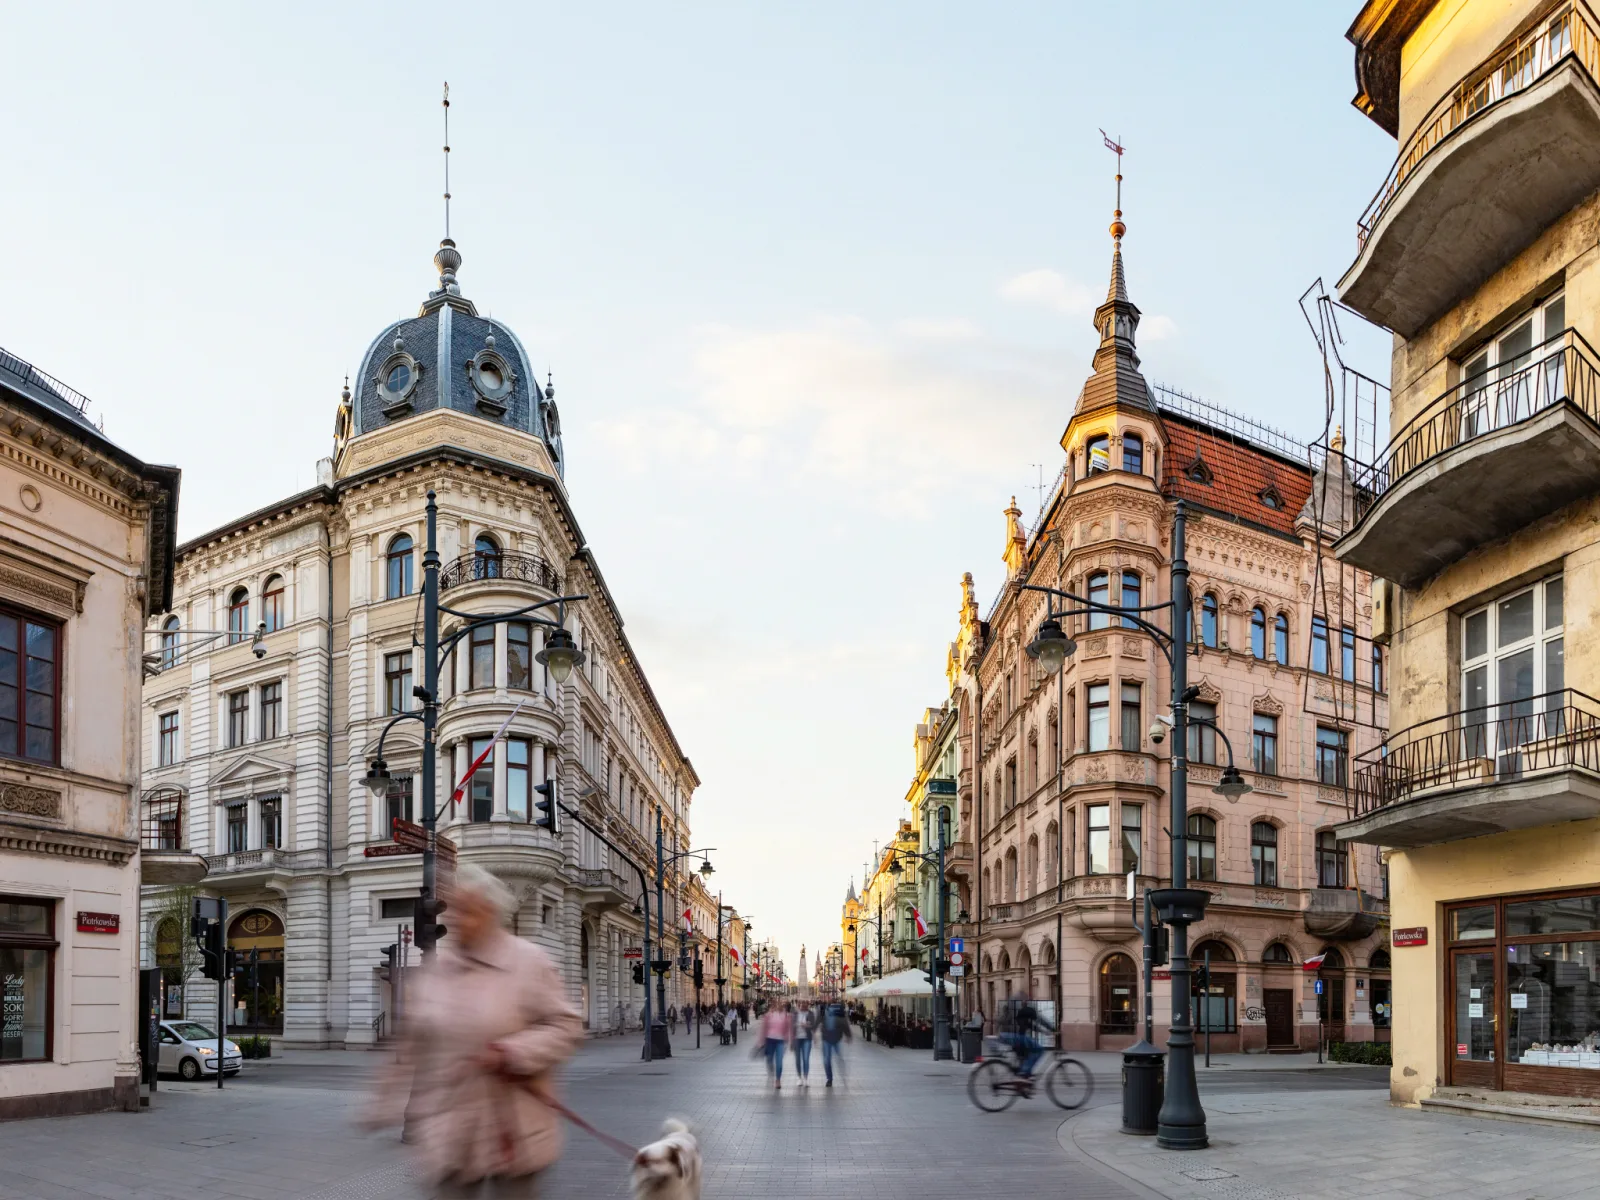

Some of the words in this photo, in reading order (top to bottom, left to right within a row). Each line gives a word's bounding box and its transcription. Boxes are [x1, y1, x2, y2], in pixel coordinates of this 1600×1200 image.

[82, 916, 116, 927] Piotrkowska
[4, 974, 25, 987] Lody
[4, 1003, 25, 1012] SOKI
